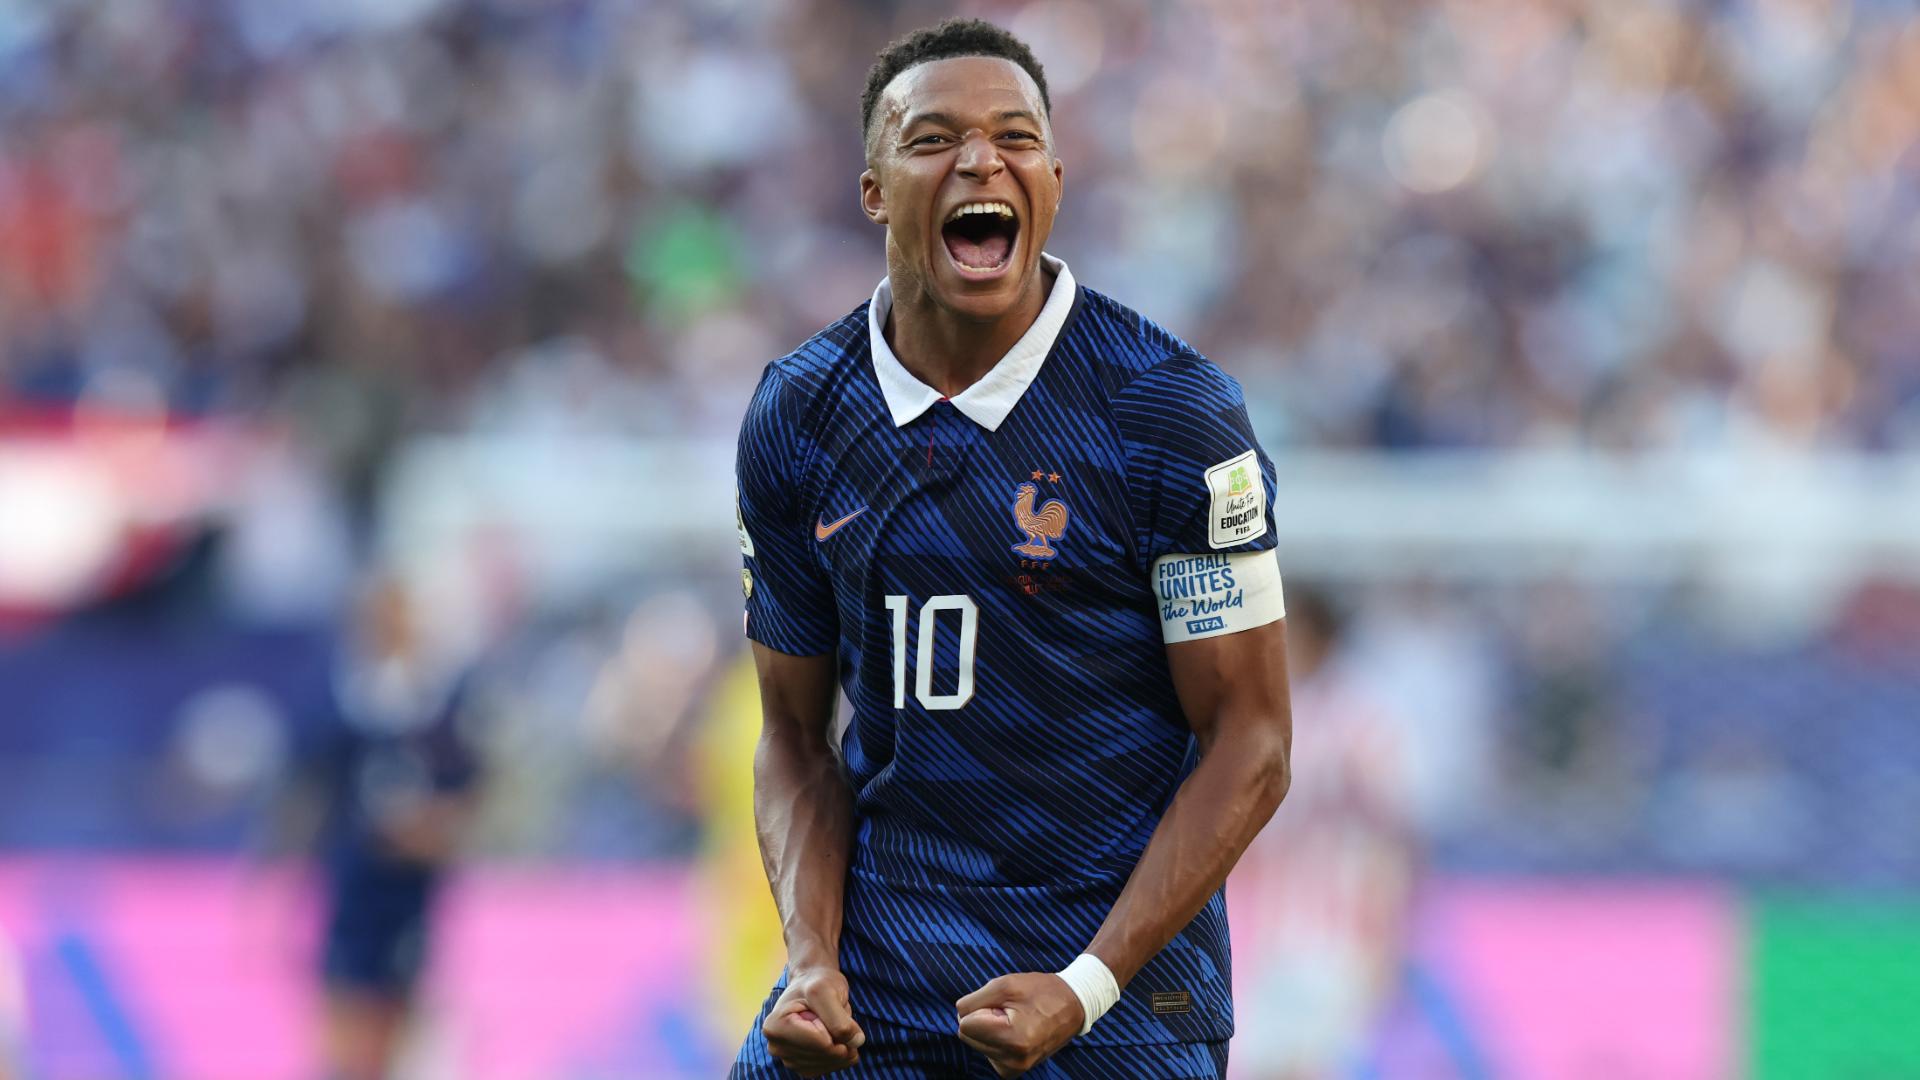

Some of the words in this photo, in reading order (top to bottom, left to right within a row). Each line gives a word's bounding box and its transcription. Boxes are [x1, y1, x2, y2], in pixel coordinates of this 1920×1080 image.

[1221, 505, 1258, 529] EDUCATION
[1226, 497, 1246, 514] Unite
[1235, 526, 1251, 535] FIFA
[1159, 554, 1231, 578] FOOTBALL
[1160, 568, 1235, 600] UNITES
[1162, 602, 1188, 621] the
[1190, 589, 1243, 616] World
[1190, 620, 1221, 632] FIFA
[885, 595, 979, 710] 10
